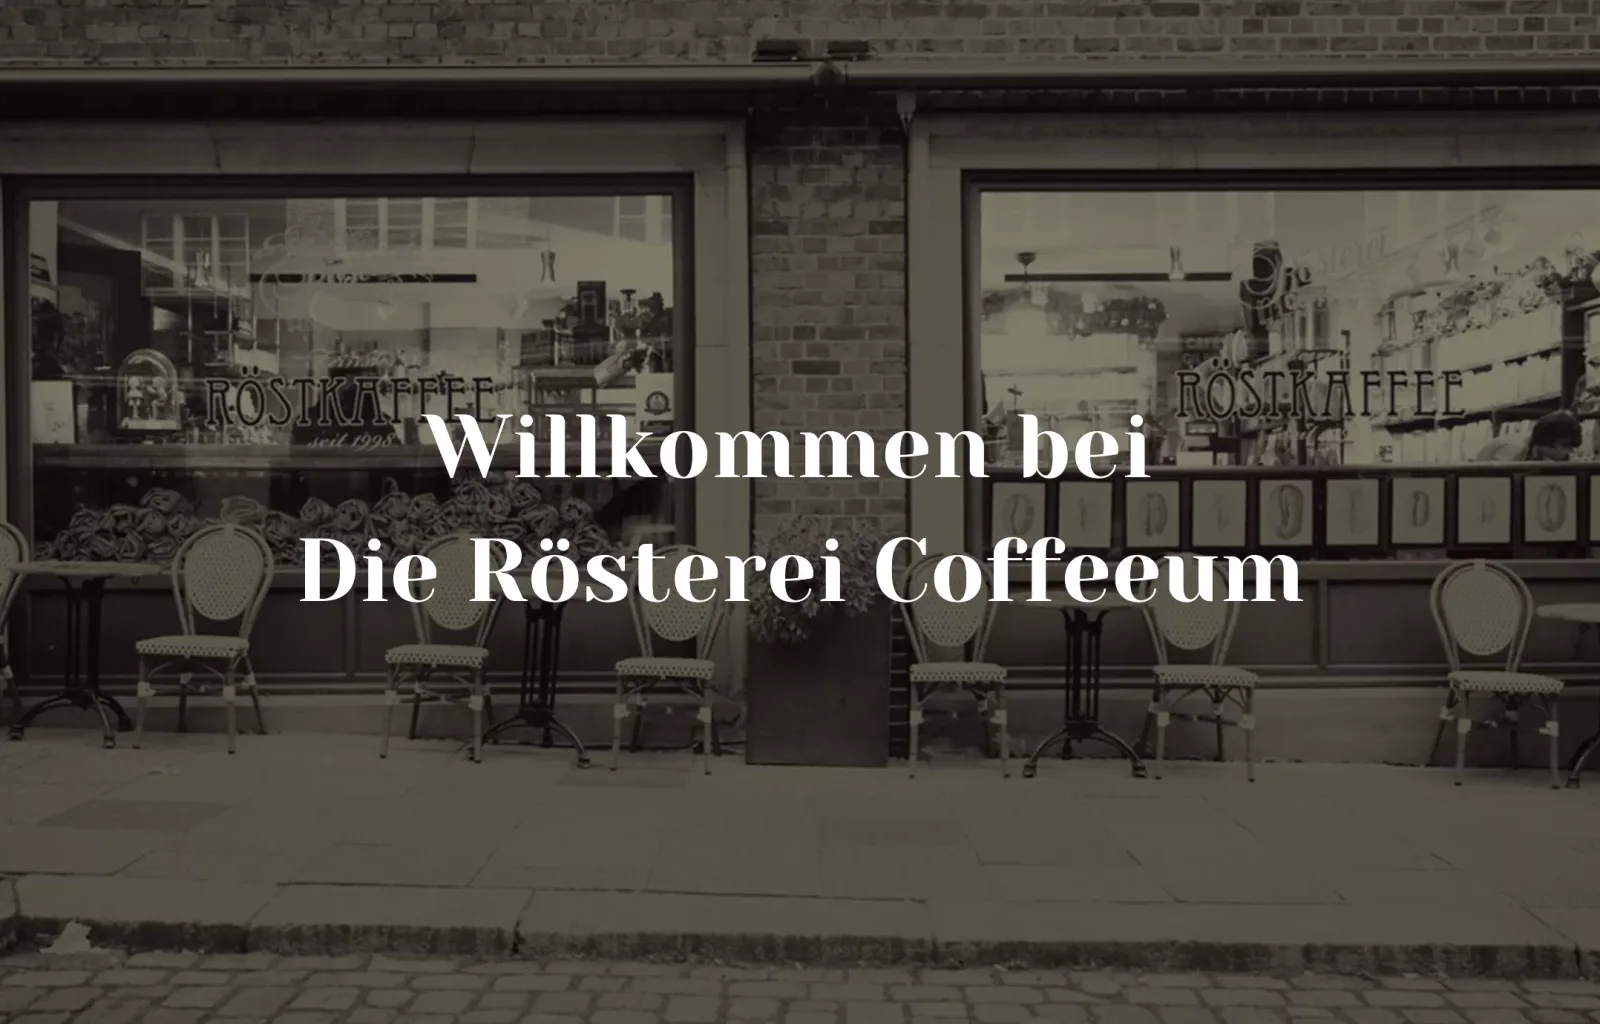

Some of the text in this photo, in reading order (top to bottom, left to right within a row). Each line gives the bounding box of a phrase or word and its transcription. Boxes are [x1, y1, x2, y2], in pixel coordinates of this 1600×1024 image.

[204, 365, 497, 426] RÖSTKAFFEE
[1176, 357, 1466, 419] RÖSTKAFFEE
[307, 432, 396, 451] seit 1998
